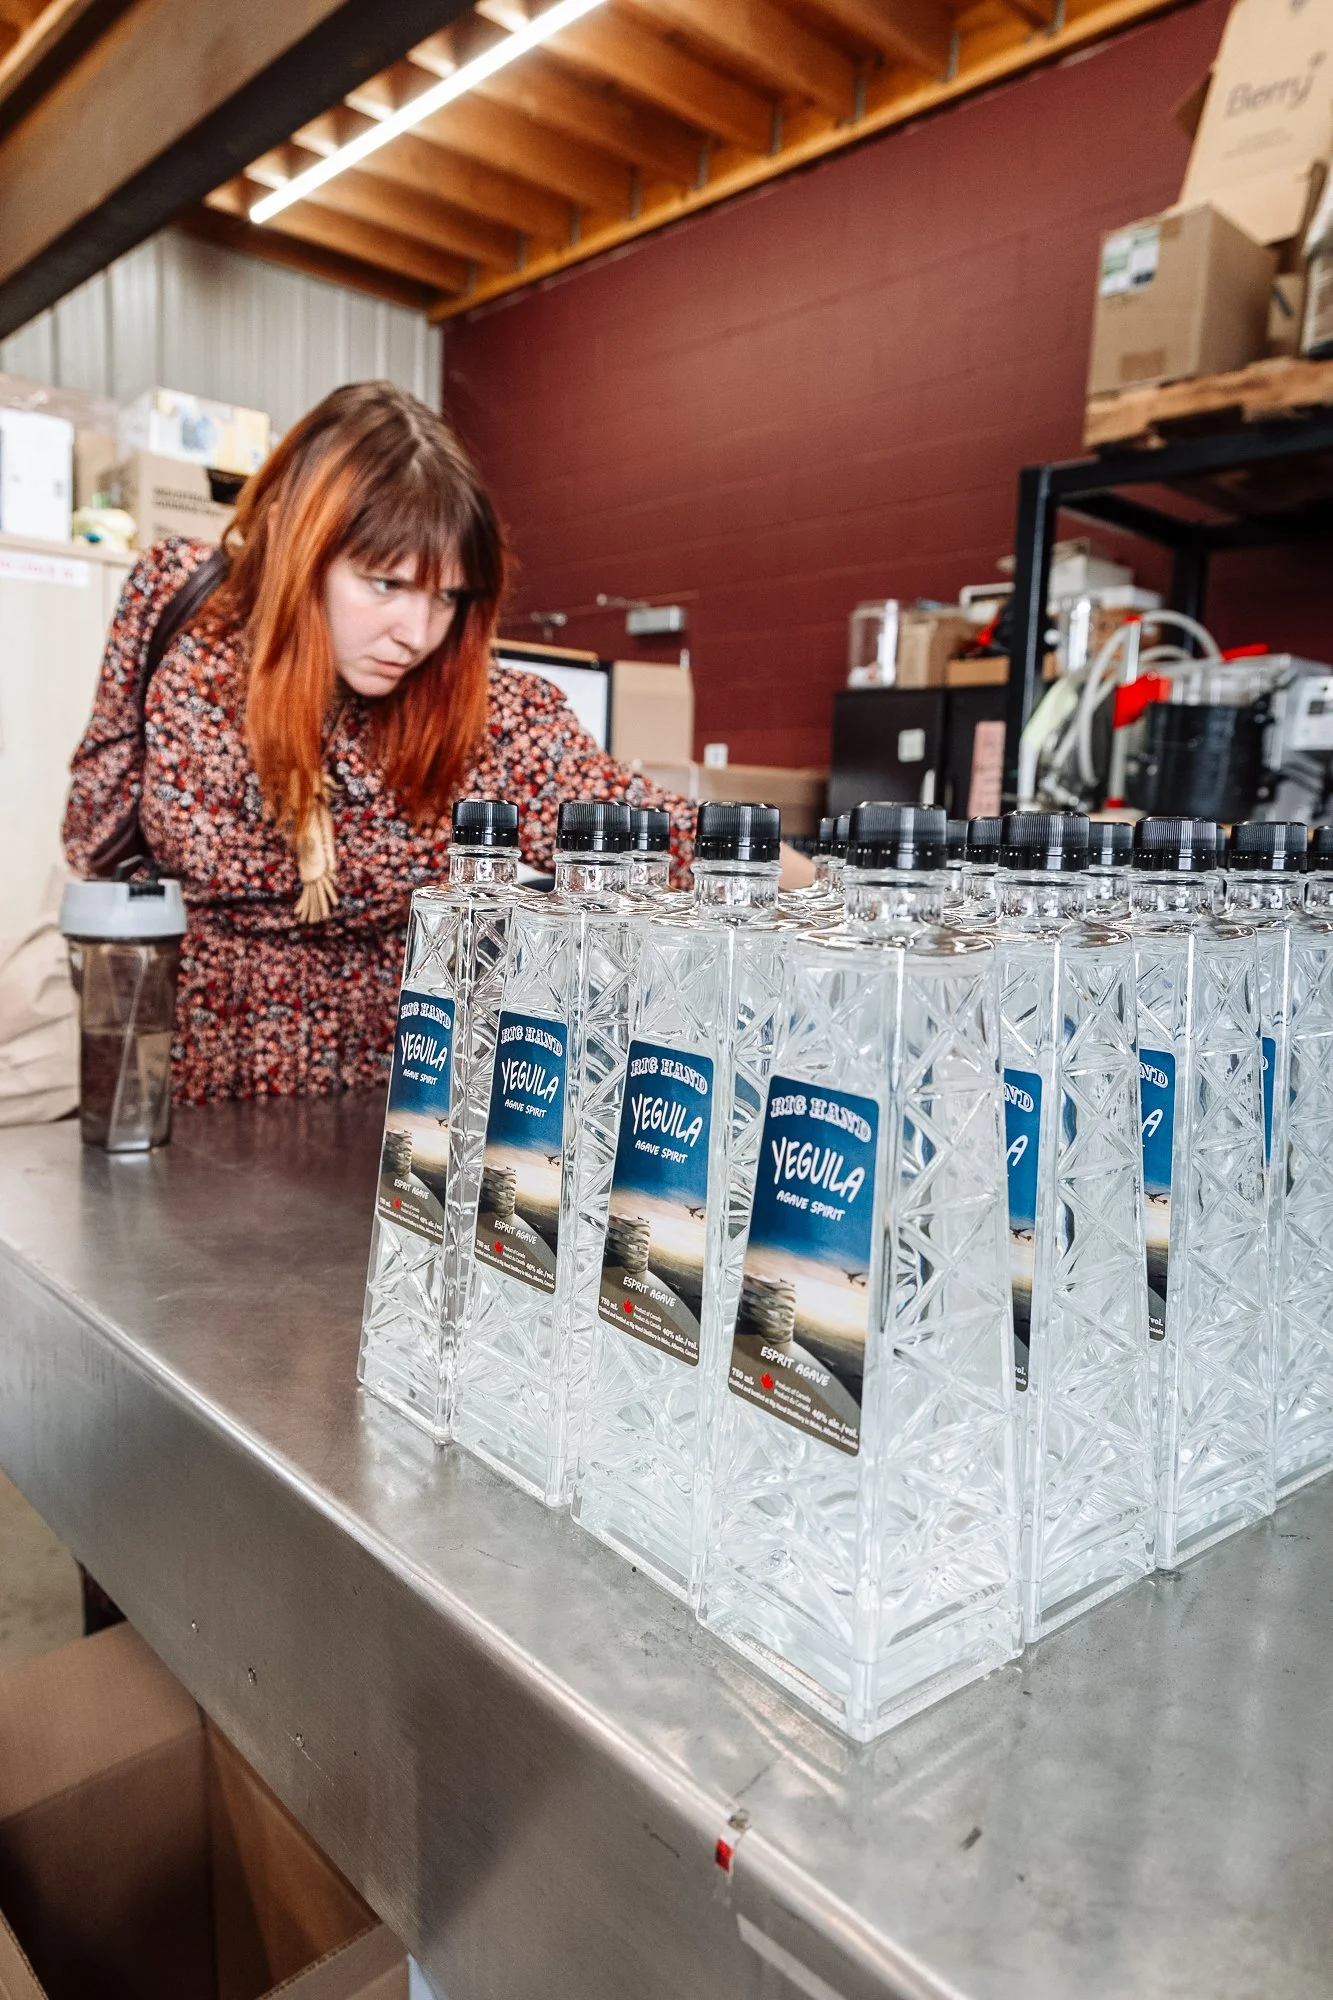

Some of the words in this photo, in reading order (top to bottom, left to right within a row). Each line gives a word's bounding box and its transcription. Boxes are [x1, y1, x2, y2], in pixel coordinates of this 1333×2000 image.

[420, 1002, 451, 1029] HAND
[401, 1032, 447, 1071] YEGUILA
[501, 1026, 523, 1044] RIG
[525, 1027, 562, 1057] HAND
[403, 1069, 419, 1080] AGAVE
[420, 1074, 438, 1085] SPIRIT
[502, 1058, 559, 1103] YEGUILA
[631, 1057, 658, 1077] RIG
[661, 1058, 708, 1095] HAND
[1140, 1062, 1168, 1088] ND
[505, 1099, 524, 1112] AGAVE
[526, 1105, 547, 1118] SPIRIT
[1004, 1082, 1034, 1112] ND
[632, 1094, 703, 1148] YEGUILA
[771, 1095, 807, 1118] RIG
[809, 1098, 871, 1143] HAND
[635, 1140, 660, 1155] AGAVE
[661, 1148, 688, 1164] SPIRIT
[772, 1136, 865, 1203] YEGUILA
[394, 1179, 411, 1192] ESPRIT
[412, 1185, 429, 1199] AGAVE
[777, 1190, 809, 1210] AGAVE
[810, 1201, 845, 1221] SPIRIT
[494, 1220, 515, 1234] ESPRIT
[516, 1230, 537, 1244] AGAVE
[623, 1276, 649, 1294] ESPRIT
[650, 1289, 676, 1307] AGAVE
[761, 1346, 795, 1368] ESPRIT
[795, 1364, 830, 1387] AGAVE
